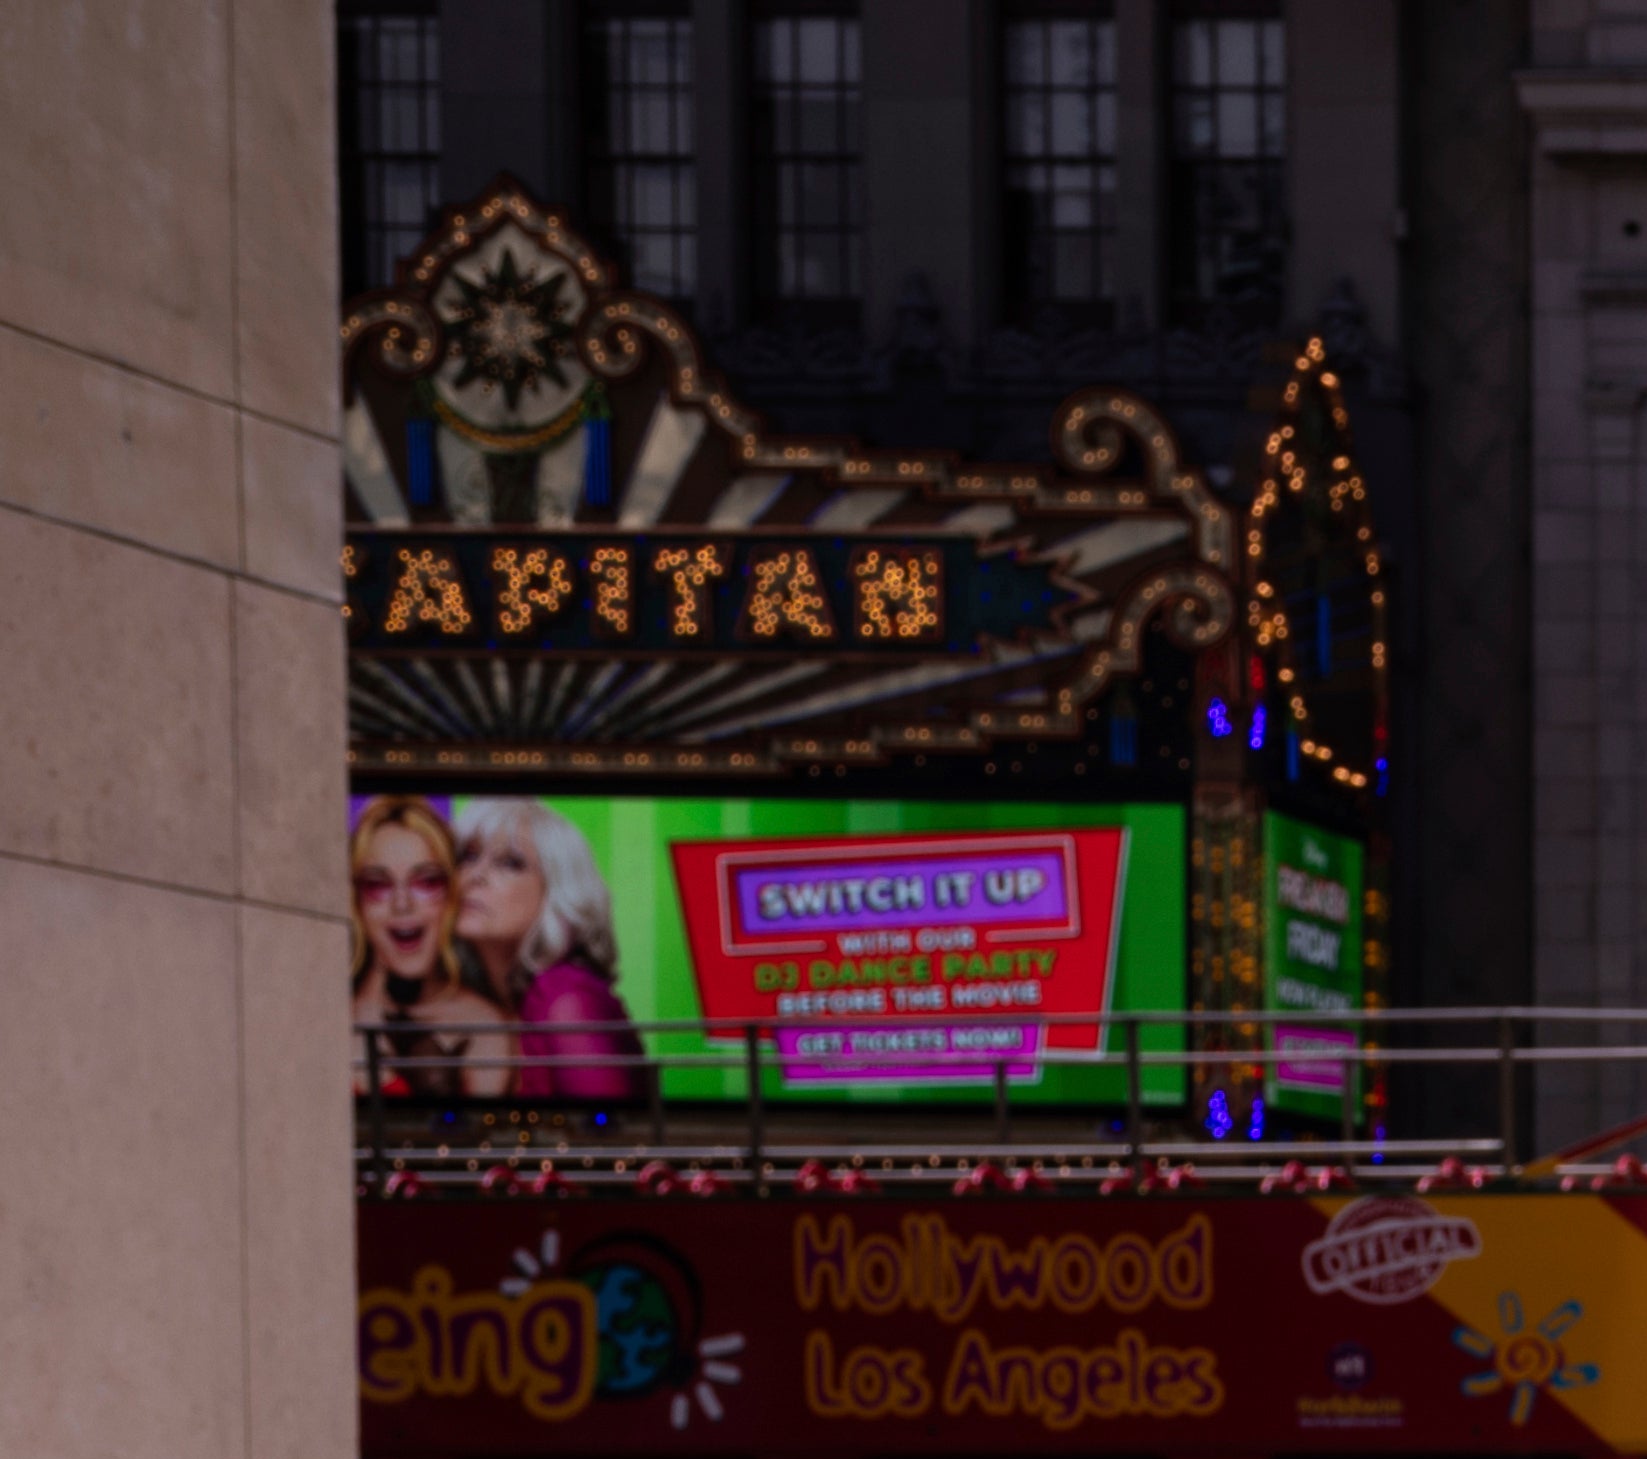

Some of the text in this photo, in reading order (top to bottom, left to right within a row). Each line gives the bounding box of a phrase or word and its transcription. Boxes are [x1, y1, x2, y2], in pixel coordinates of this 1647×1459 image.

[345, 542, 949, 640] APITAN
[759, 868, 1045, 919] SWITCH IT UP
[837, 926, 977, 955] WITH OUR
[753, 948, 1058, 991] DJ DANCE PARTY
[776, 980, 1042, 1017] BEFORE THE MOVIE
[795, 1211, 1212, 1323] Hollywood
[804, 1330, 1225, 1432] Los Angeles
